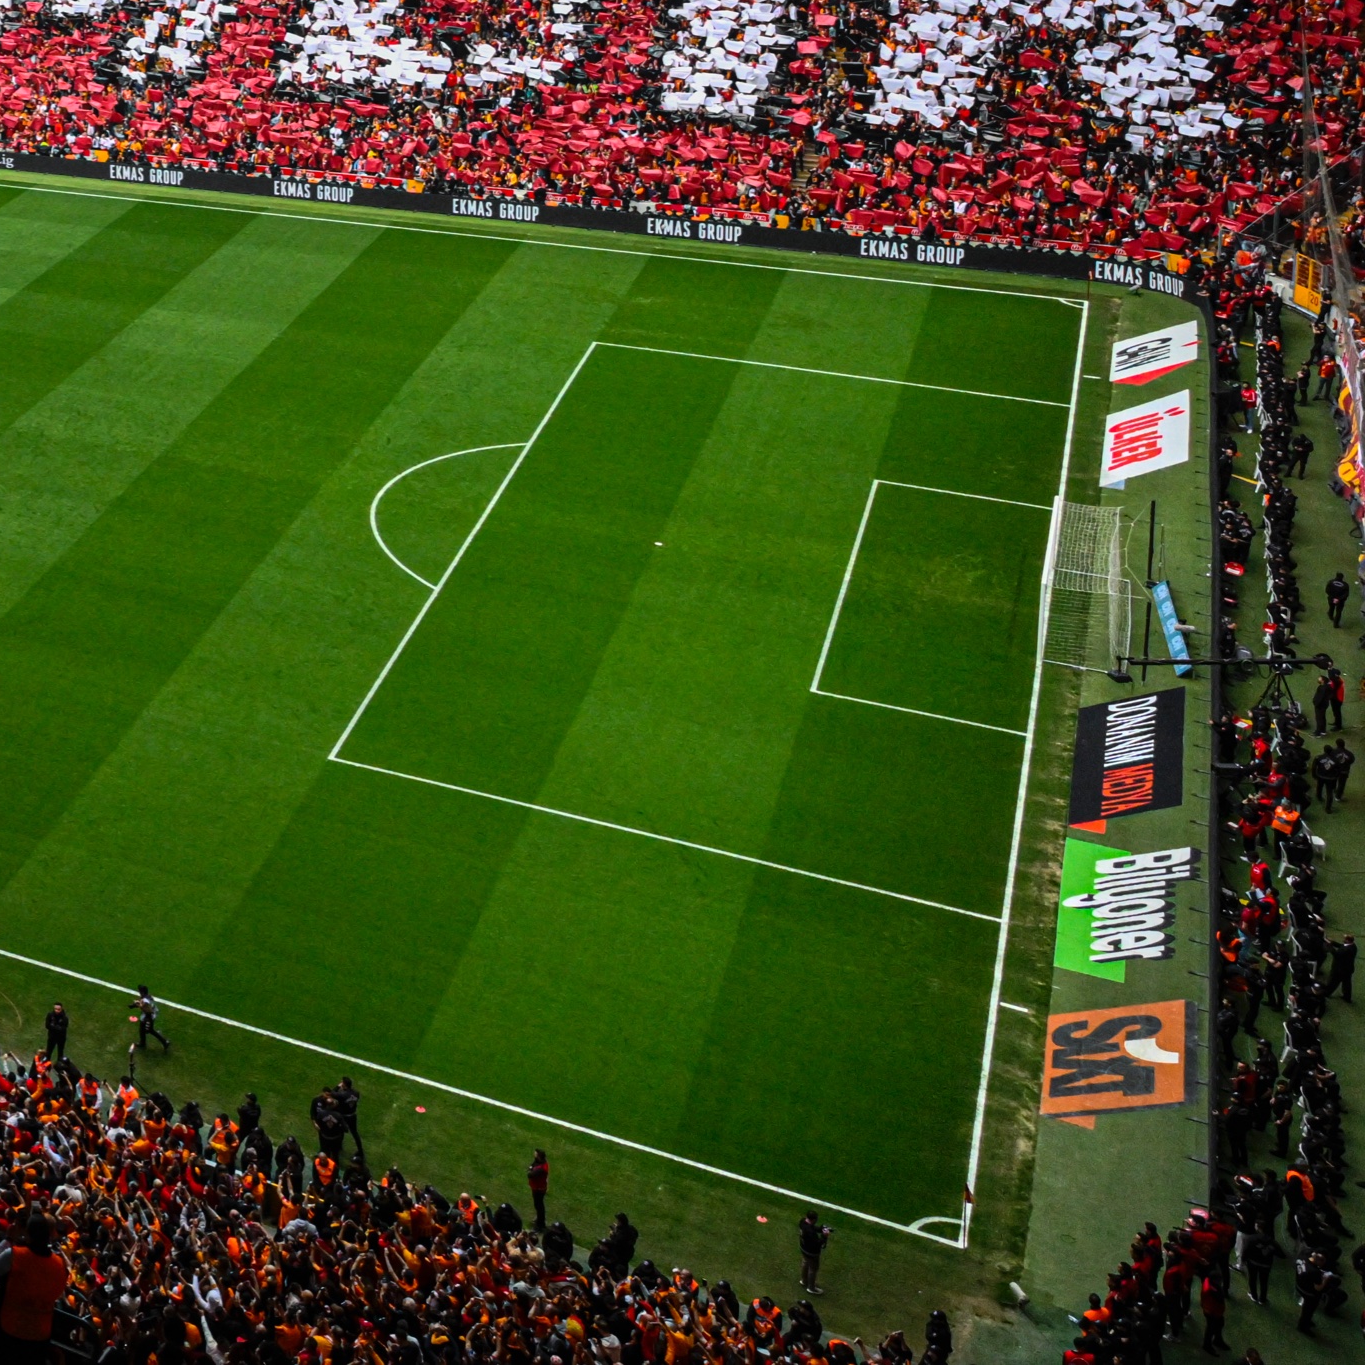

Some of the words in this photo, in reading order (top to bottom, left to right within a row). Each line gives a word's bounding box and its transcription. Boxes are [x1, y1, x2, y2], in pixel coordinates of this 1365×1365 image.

[109, 164, 144, 182] EKMAS
[149, 167, 184, 186] GROUP
[274, 180, 311, 199] EKMAS
[316, 184, 354, 203] GROUP
[452, 198, 493, 218] EKMAS
[499, 202, 540, 222] GROUP
[647, 217, 691, 238] EKMAS
[698, 222, 742, 243] GROUP
[860, 238, 909, 260] EKMAS
[916, 244, 965, 266] GROUP
[1094, 260, 1143, 286] EKMAS
[1148, 270, 1184, 298] GROUP
[1108, 406, 1185, 471] ÜLKER
[1103, 695, 1157, 767] DONANIM
[1100, 763, 1154, 817] MEDYA
[1062, 846, 1193, 962] Bilyoner
